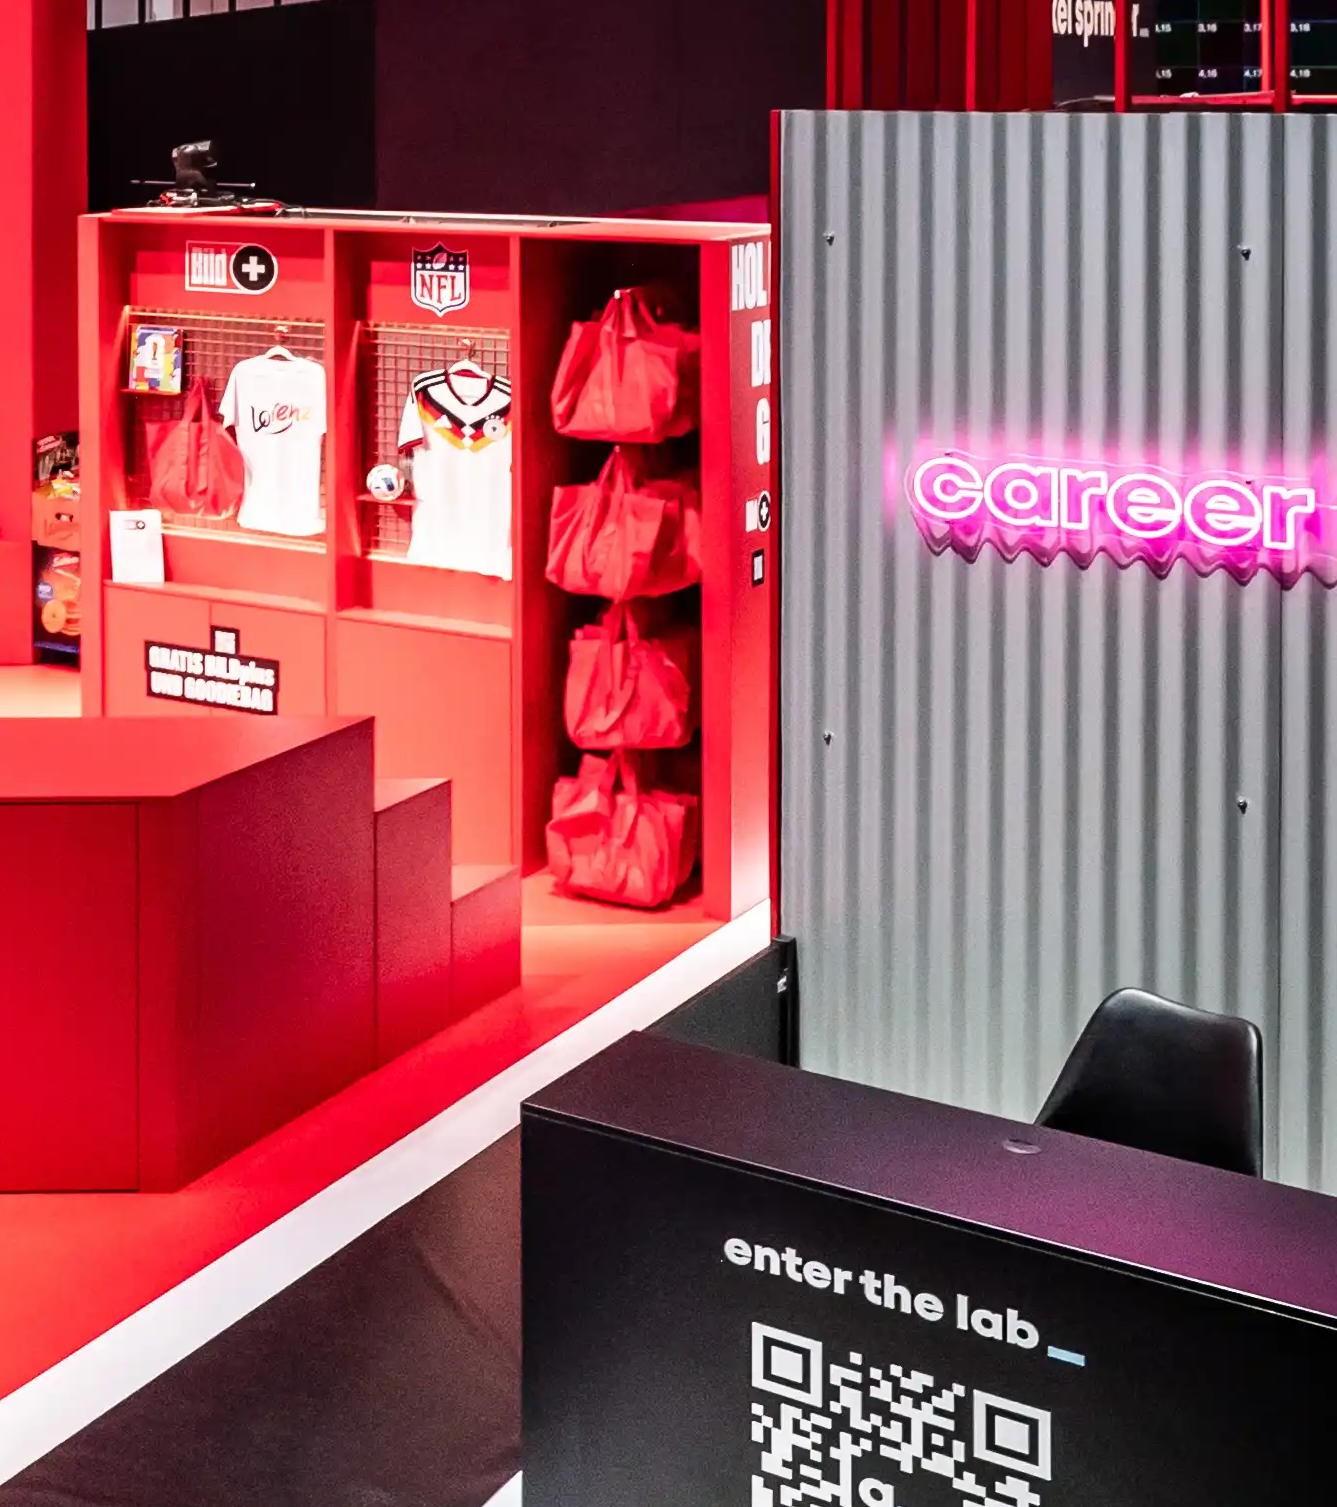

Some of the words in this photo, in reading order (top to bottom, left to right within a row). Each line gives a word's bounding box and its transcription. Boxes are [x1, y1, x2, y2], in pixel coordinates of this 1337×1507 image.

[190, 247, 228, 286] Bild
[418, 272, 462, 304] NFL
[250, 401, 312, 434] Lorenz
[913, 457, 1316, 550] career
[148, 645, 204, 675] GRATIS
[724, 1236, 853, 1295] enter
[859, 1268, 944, 1322] the
[956, 1293, 1040, 1349] lab
